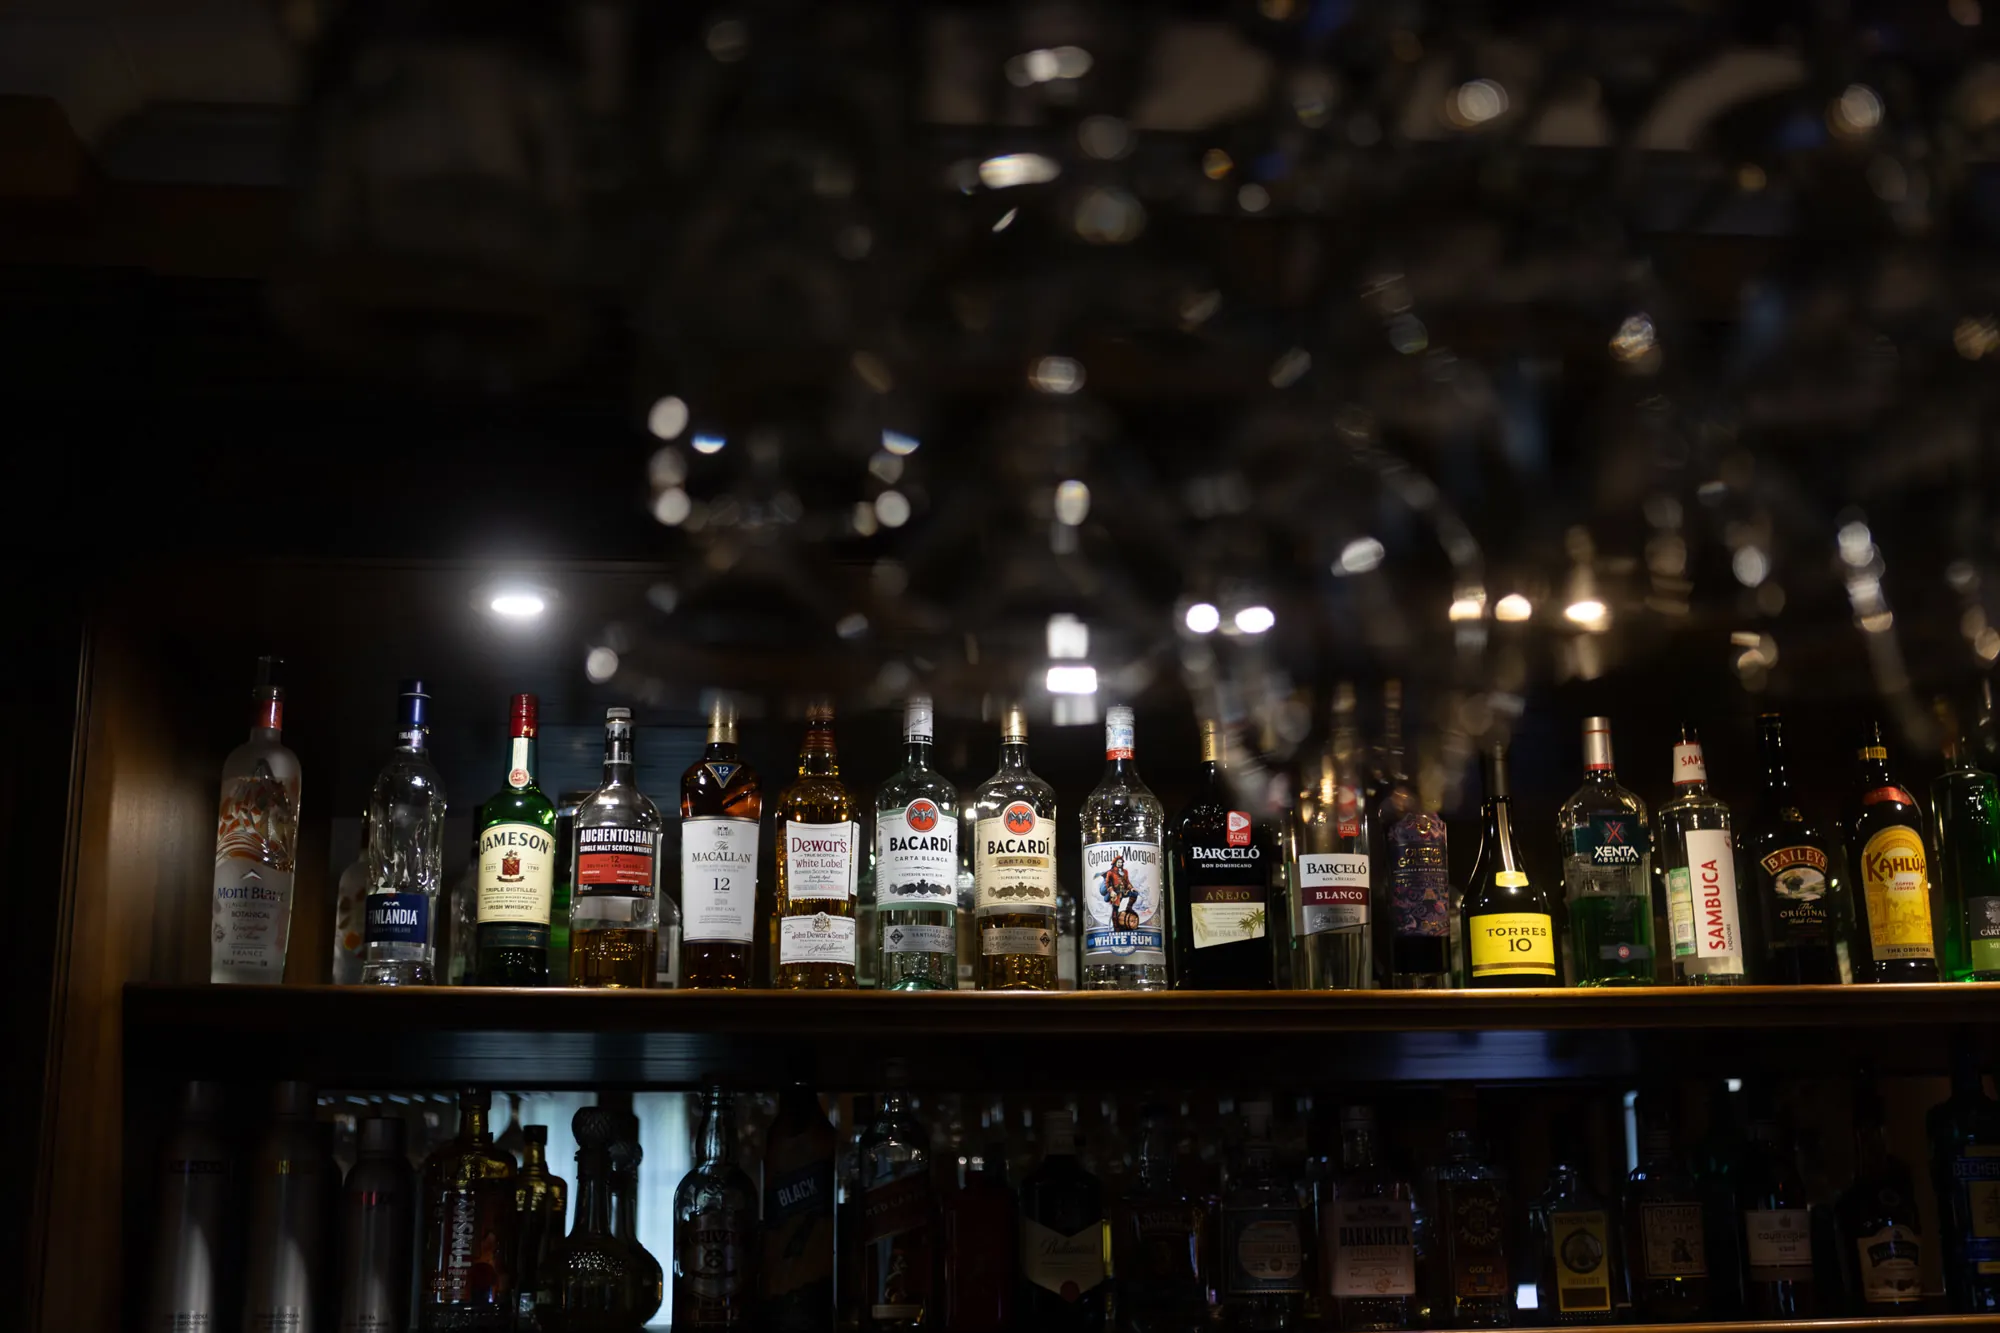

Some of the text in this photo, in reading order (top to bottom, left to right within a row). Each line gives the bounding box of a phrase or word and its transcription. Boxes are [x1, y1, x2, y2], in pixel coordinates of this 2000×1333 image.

[718, 766, 729, 774] 12
[480, 831, 550, 856] JAMESON
[580, 828, 654, 845] AUCHENTOSHAN
[889, 835, 953, 853] BACARDÍ
[580, 845, 597, 853] SINGLE
[597, 844, 611, 852] MALT
[634, 845, 653, 854] WHISKY
[714, 840, 730, 852] The
[791, 837, 848, 854] Dewar's
[987, 837, 1050, 856] BACARDÍ
[1192, 845, 1260, 861] BARCELÓ
[1594, 845, 1639, 859] XENTA
[610, 855, 620, 864] 12
[692, 851, 752, 864] MACALLAN
[922, 855, 948, 863] BLANCA
[1088, 846, 1157, 868] Captain Morgan
[1767, 849, 1827, 870] BAILEYS
[1306, 861, 1367, 876] BARCELÓ
[1866, 851, 1927, 882] KAHLÚA
[712, 877, 731, 892] 12
[218, 886, 248, 900] Mont
[1205, 889, 1251, 901] AÑEJO
[1315, 891, 1363, 900] BLANCO
[504, 903, 533, 911] WHISKEY
[1701, 859, 1726, 951] SAMBUCA
[368, 908, 419, 926] FINLANDIA
[1779, 909, 1828, 919] ORIGINAL
[1486, 927, 1547, 937] TORRES
[1094, 935, 1153, 947] WHITE RUM
[1508, 938, 1533, 953] 10
[777, 1176, 818, 1207] BLACK
